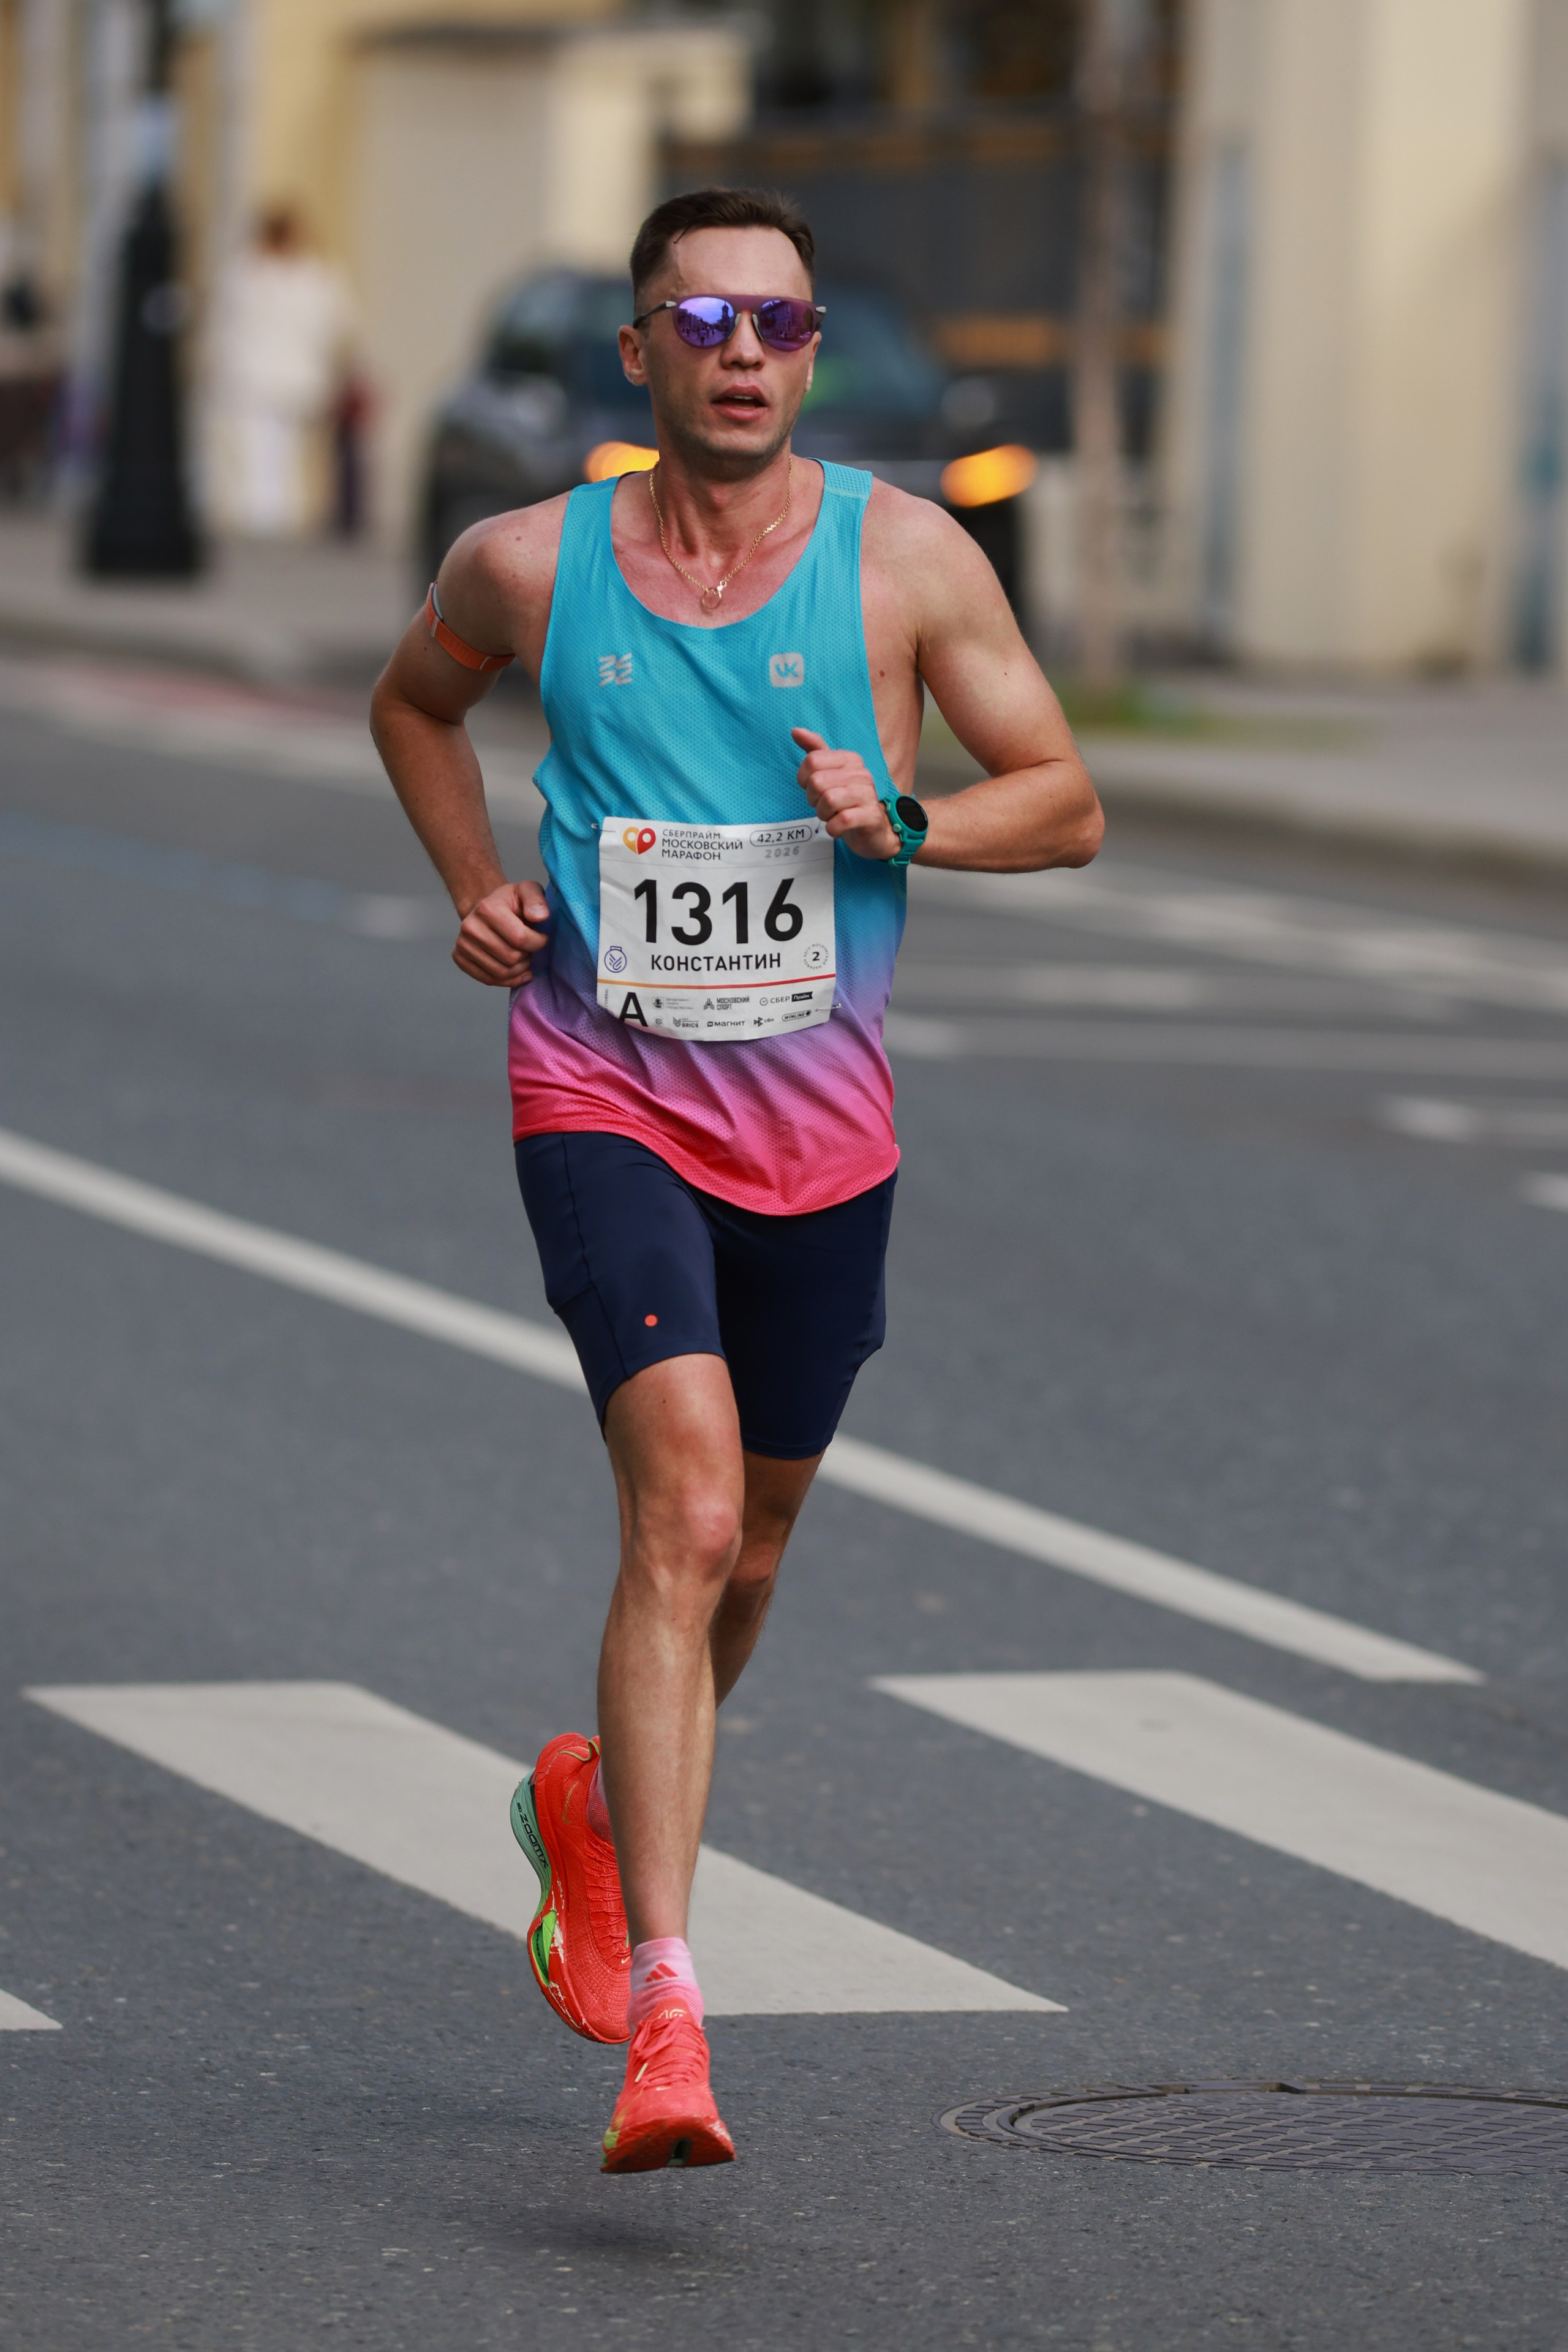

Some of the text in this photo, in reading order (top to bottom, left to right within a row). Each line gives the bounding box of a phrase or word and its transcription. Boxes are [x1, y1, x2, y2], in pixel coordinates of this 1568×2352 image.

[662, 829, 720, 839] СБЕРПРАЙМ
[757, 832, 783, 843] 42,2
[662, 838, 742, 850] МОСКОВСКИЙ
[662, 849, 721, 860] МАРАФОН
[764, 846, 800, 859] 2026
[634, 878, 804, 946] 1316
[650, 953, 781, 971] КОНСТАНТИН
[812, 951, 820, 962] 2
[784, 1012, 805, 1020] WINLINE
